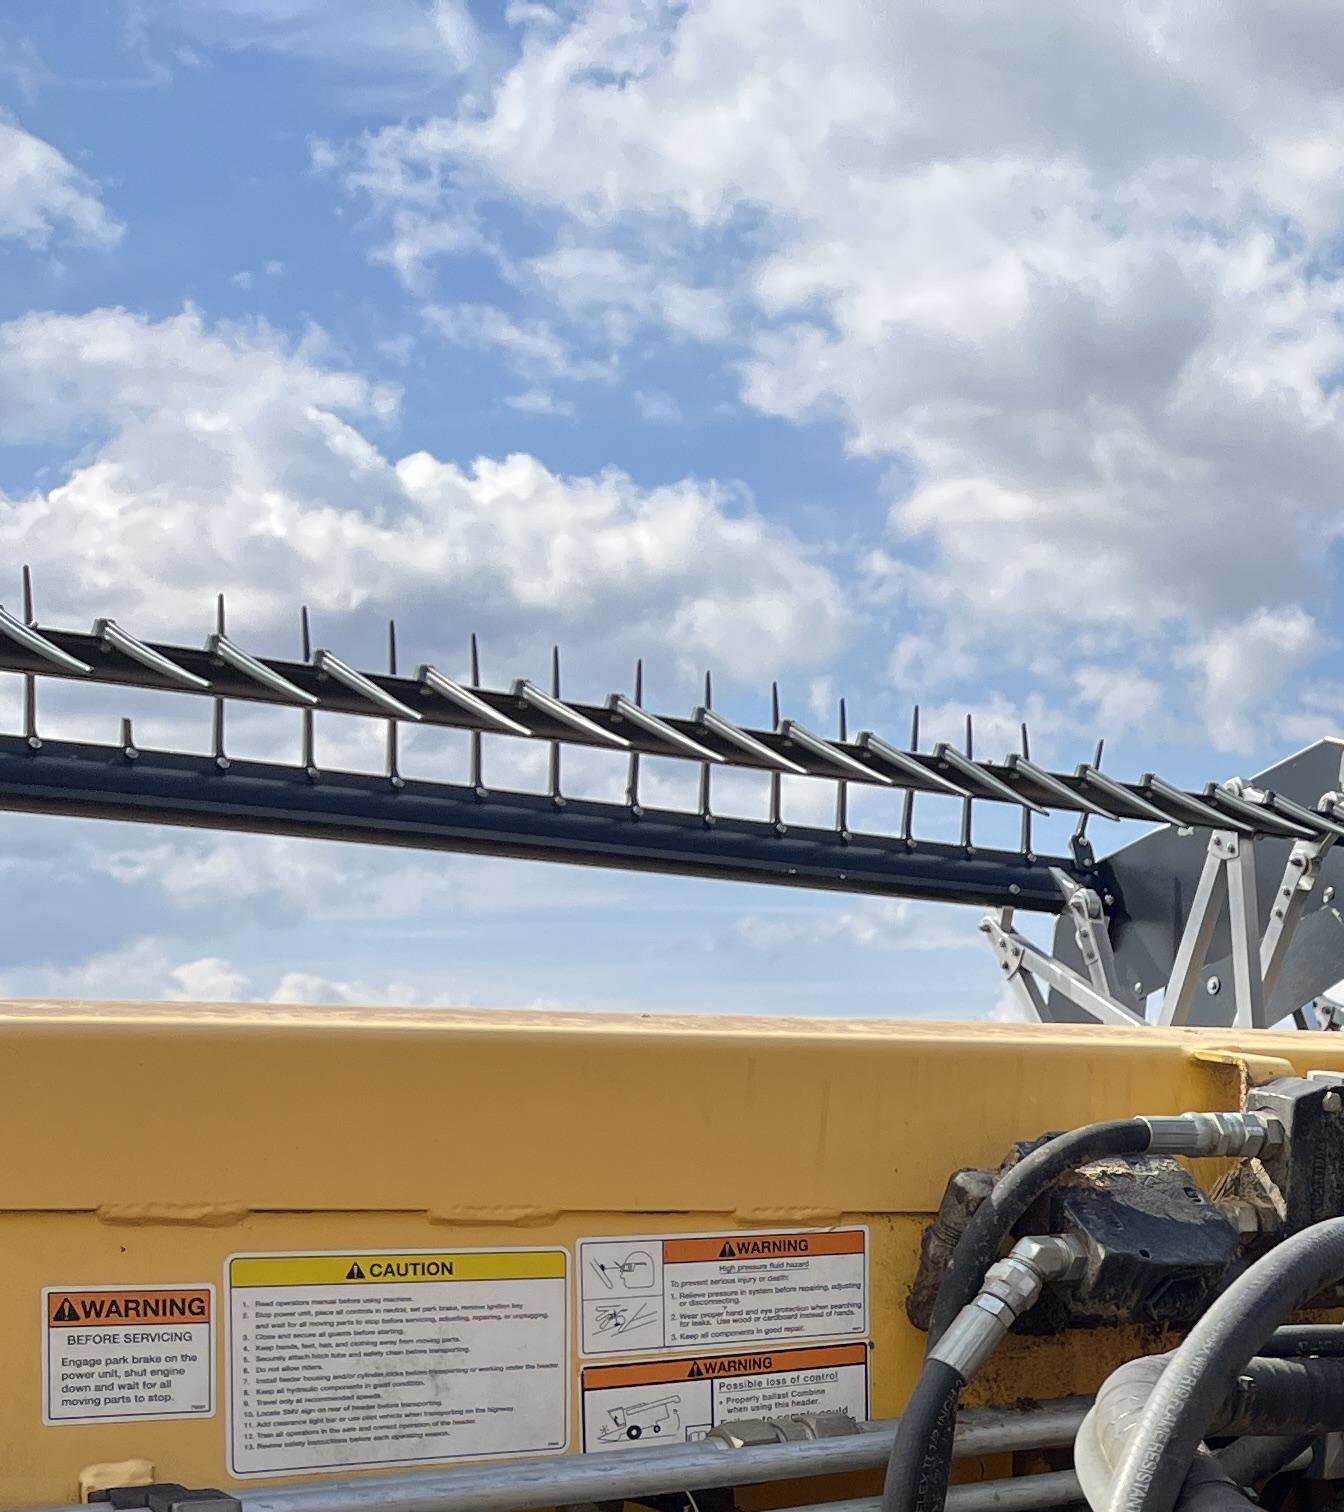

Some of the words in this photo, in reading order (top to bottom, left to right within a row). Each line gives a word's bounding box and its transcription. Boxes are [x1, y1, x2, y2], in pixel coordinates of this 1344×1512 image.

[736, 1239, 808, 1254] WARNING
[370, 1262, 454, 1277] CAUTION
[719, 1265, 736, 1273] High
[738, 1263, 768, 1271] pressure
[681, 1279, 708, 1288] prevent
[710, 1278, 736, 1286] serious
[738, 1276, 756, 1285] injury
[679, 1291, 706, 1299] Relieve
[708, 1290, 738, 1299] pressure
[749, 1288, 773, 1297] system
[775, 1286, 797, 1294] before
[831, 1282, 861, 1291] adjusting
[81, 1297, 205, 1318] WARNING
[689, 1297, 741, 1306] disconnecting.
[700, 1312, 724, 1321] proper
[726, 1309, 743, 1317] hand
[760, 1308, 772, 1316] eye
[775, 1306, 809, 1314] protection
[830, 1302, 861, 1310] searching
[692, 1319, 712, 1327] leaks.
[763, 1313, 798, 1321] cardboard
[67, 1333, 120, 1345] BEFORE
[123, 1331, 193, 1344] SERVICING
[680, 1332, 699, 1340] Keep
[711, 1329, 754, 1339] components
[764, 1327, 782, 1335] good
[62, 1357, 102, 1368] Engage
[105, 1355, 128, 1367] park
[132, 1355, 161, 1364] brake
[180, 1354, 197, 1362] the
[704, 1357, 772, 1374] WARNING
[62, 1371, 95, 1381] power
[98, 1370, 121, 1379] unit,
[124, 1368, 147, 1378] shut
[150, 1367, 185, 1377] engine
[719, 1381, 762, 1391] Possible
[767, 1377, 787, 1386] loss
[790, 1375, 800, 1384] of
[803, 1371, 838, 1382] control
[62, 1384, 91, 1393] down
[95, 1382, 114, 1392] and
[118, 1381, 139, 1390] wait
[143, 1381, 157, 1389] for
[160, 1380, 172, 1388] all
[62, 1397, 100, 1406] moving
[104, 1395, 131, 1405] parts
[135, 1395, 145, 1403] to
[148, 1394, 174, 1403] stop.
[726, 1395, 760, 1404] Properly
[762, 1391, 789, 1400] ballast
[791, 1388, 825, 1397] Combine
[727, 1406, 748, 1414] when
[751, 1403, 772, 1412] using
[1153, 1398, 1185, 1439] FLAME
